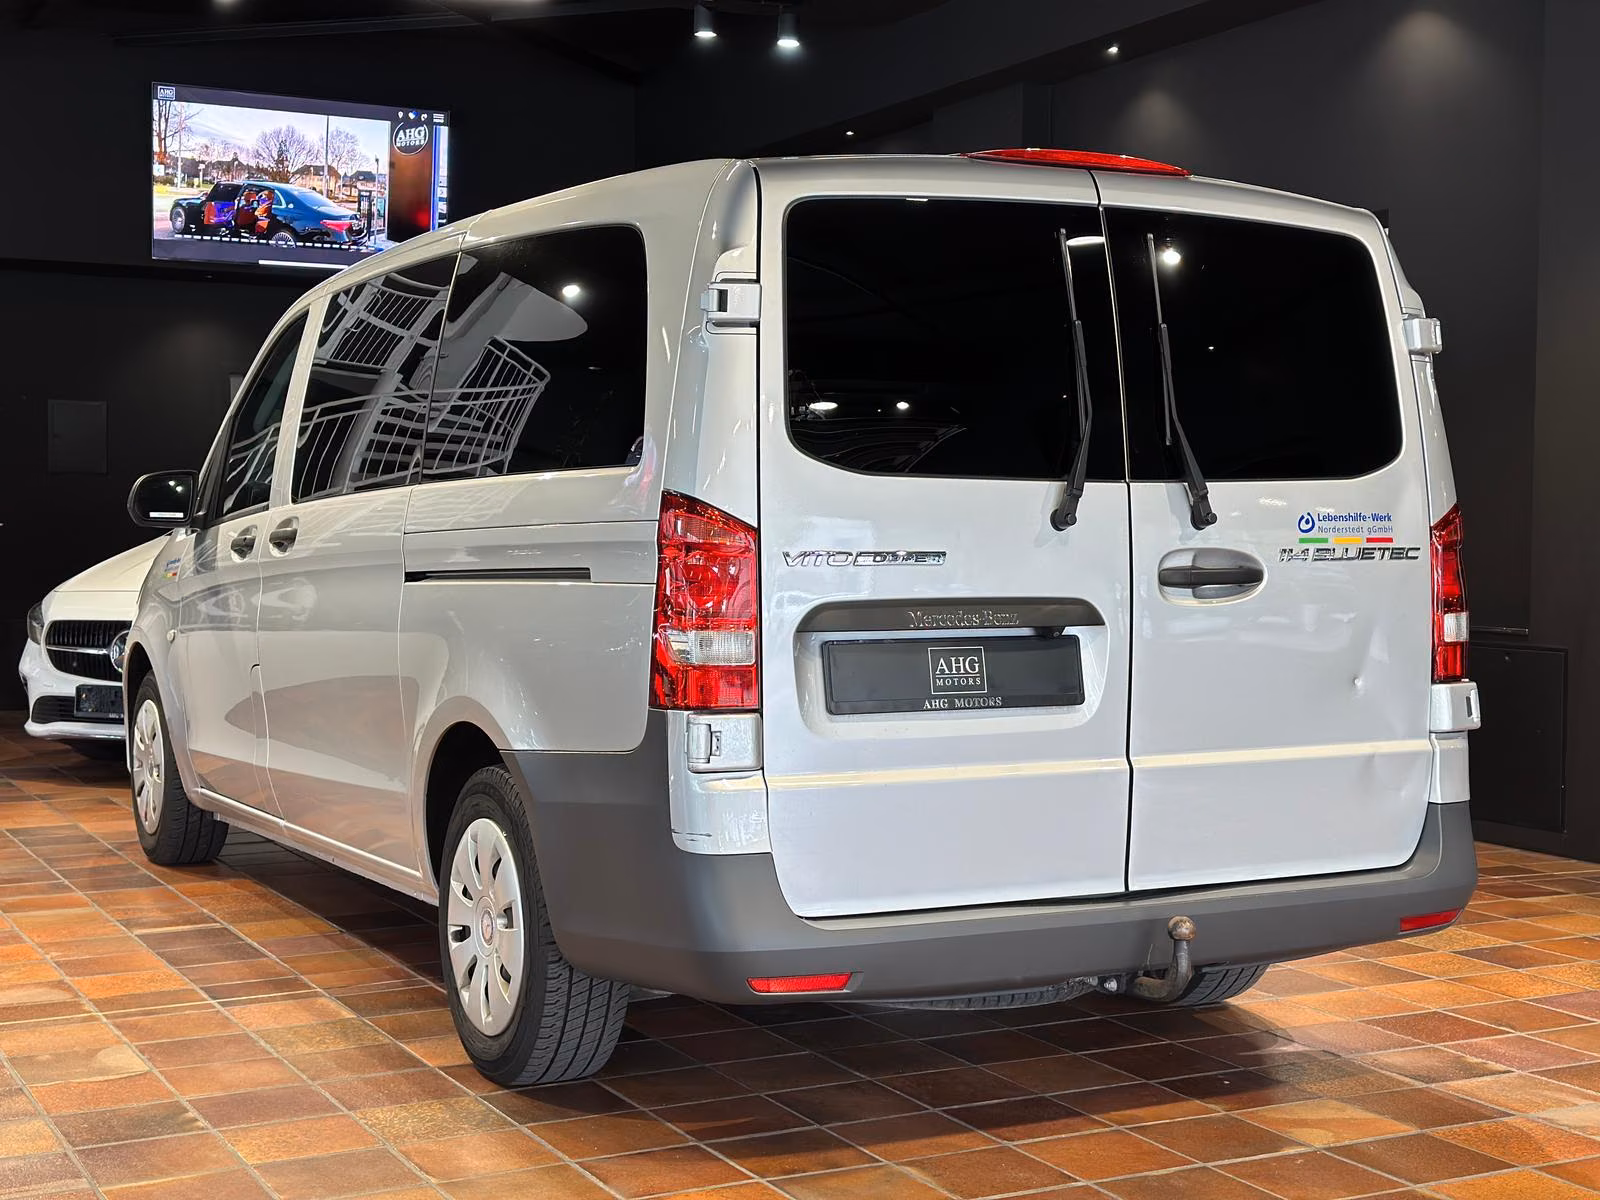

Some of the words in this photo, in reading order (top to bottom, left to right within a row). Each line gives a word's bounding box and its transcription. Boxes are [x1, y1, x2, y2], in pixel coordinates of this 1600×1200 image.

[396, 126, 425, 141] AHG
[1317, 512, 1392, 522] Lebenshilfe-Werk
[1317, 525, 1364, 534] Norderstedt
[1367, 524, 1393, 535] gGmbH
[782, 551, 853, 567] VITO
[1311, 546, 1421, 561] BLUETEC
[907, 610, 1020, 628] Mercedes-Benz
[935, 656, 980, 675] AHG
[936, 676, 981, 687] MOTORS
[923, 698, 949, 710] AHG
[954, 695, 1003, 709] MOTORS
